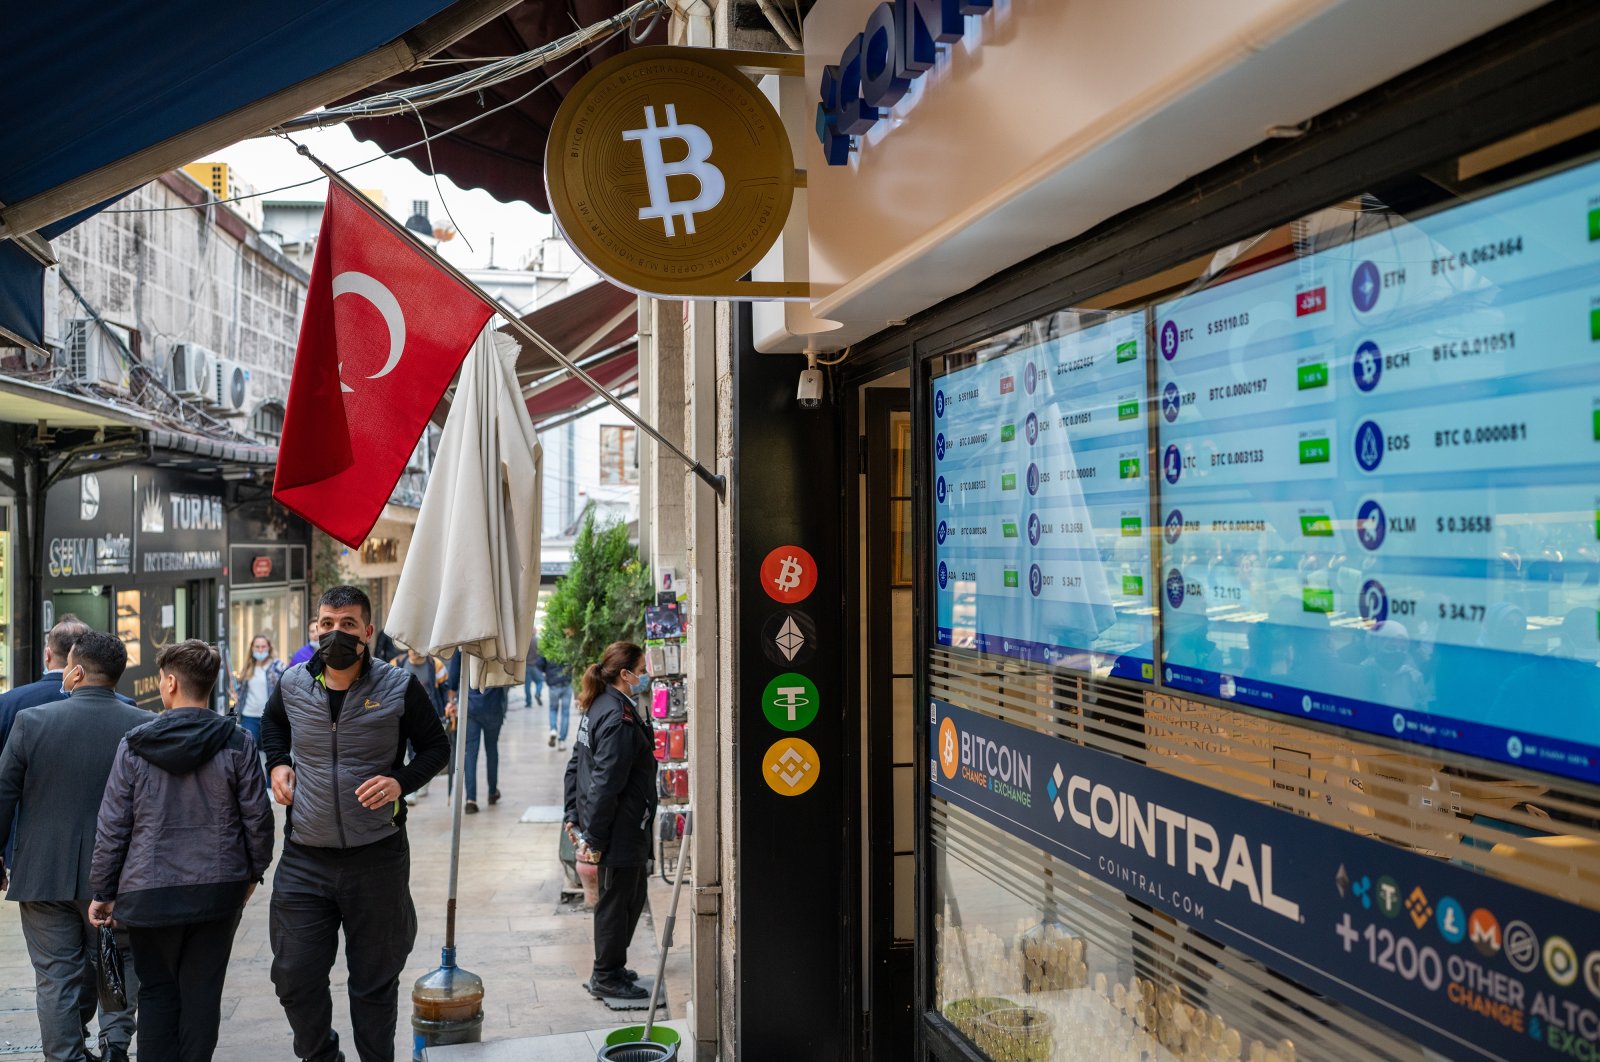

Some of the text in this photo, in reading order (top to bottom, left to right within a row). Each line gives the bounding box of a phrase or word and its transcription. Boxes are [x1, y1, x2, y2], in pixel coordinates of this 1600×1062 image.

[837, 0, 994, 136] COIN
[570, 116, 588, 159] BITCOIN
[1431, 236, 1524, 275] BTC 0.062464
[1384, 269, 1406, 288] ETH
[1214, 313, 1249, 334] 55110.03
[1180, 327, 1194, 342] BTC
[1433, 330, 1516, 362] BTC 0.01051
[1057, 363, 1068, 375] BTC
[1386, 352, 1410, 371] BCH
[1181, 392, 1196, 406] XRP
[1209, 387, 1224, 401] BTC
[1039, 421, 1050, 432] BCH
[1070, 412, 1092, 425] 0.01051
[1387, 434, 1411, 451] EOS
[1435, 422, 1527, 447] BTC 0.000081
[1183, 456, 1196, 469] LTC
[1211, 449, 1264, 466] BTC 0.003133
[169, 493, 223, 530] TURAN
[1041, 524, 1053, 534] XLM
[1065, 523, 1084, 533] 0.3658
[1212, 520, 1227, 531] BTC
[1389, 517, 1416, 532] XLM
[1436, 516, 1492, 534] $ 0.3658
[144, 551, 222, 573] INTERNATIONAL
[1043, 576, 1054, 585] DOT
[1066, 576, 1082, 587] 34.77
[1186, 584, 1202, 596] ADA
[1220, 587, 1241, 600] 2.113
[1391, 600, 1416, 615] DOT
[1439, 603, 1486, 622] $ 34.77
[962, 730, 1031, 792] BITCOIN
[962, 765, 988, 789] CHANGE
[994, 779, 1031, 808] EXCHANGE
[1067, 775, 1299, 922] COINTRAL
[1099, 856, 1204, 920] COINTRAL.COM
[1447, 955, 1600, 1041] OTHER ALTC
[1447, 982, 1524, 1028] CHANGE
